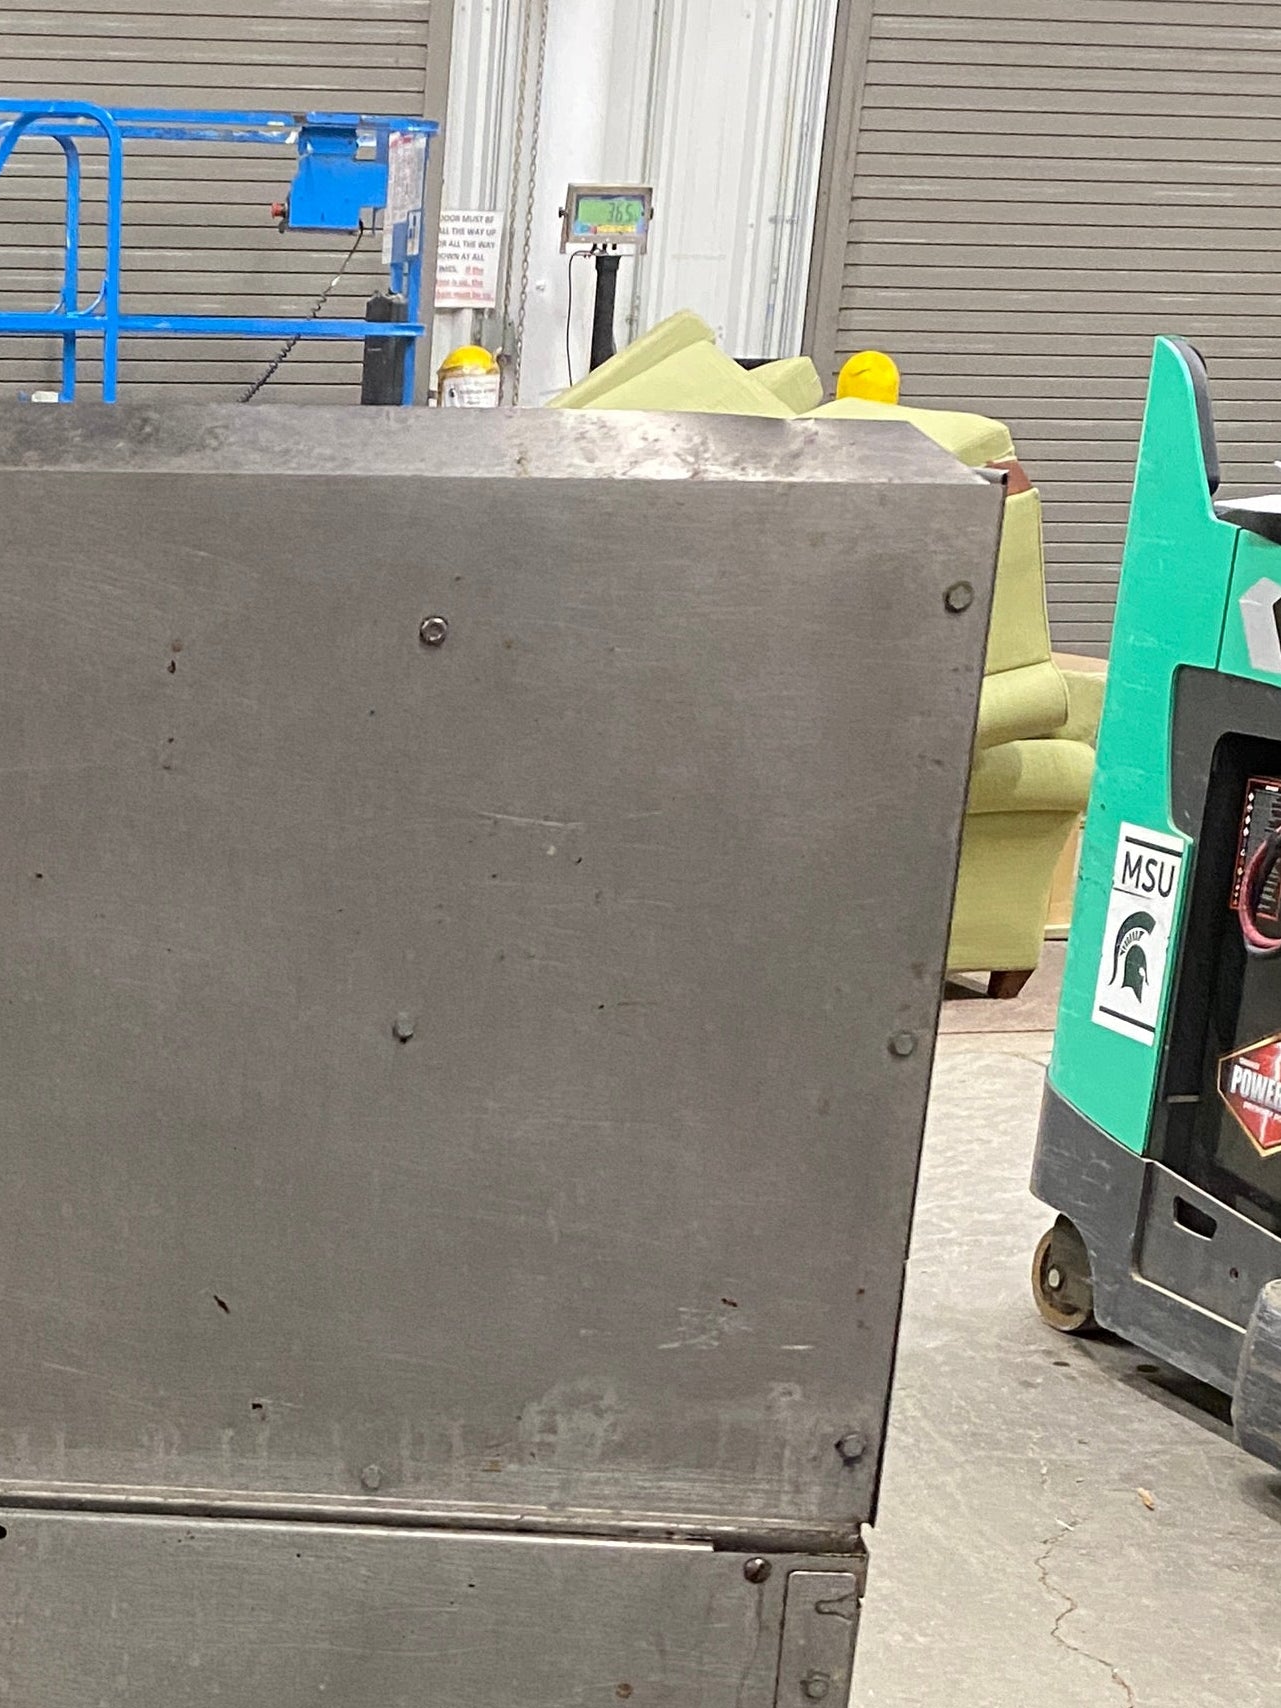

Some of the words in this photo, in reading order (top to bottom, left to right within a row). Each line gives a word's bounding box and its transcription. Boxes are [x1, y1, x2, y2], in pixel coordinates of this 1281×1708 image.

[467, 228, 484, 236] WAY
[478, 241, 495, 249] WAY
[1122, 851, 1175, 897] MSU
